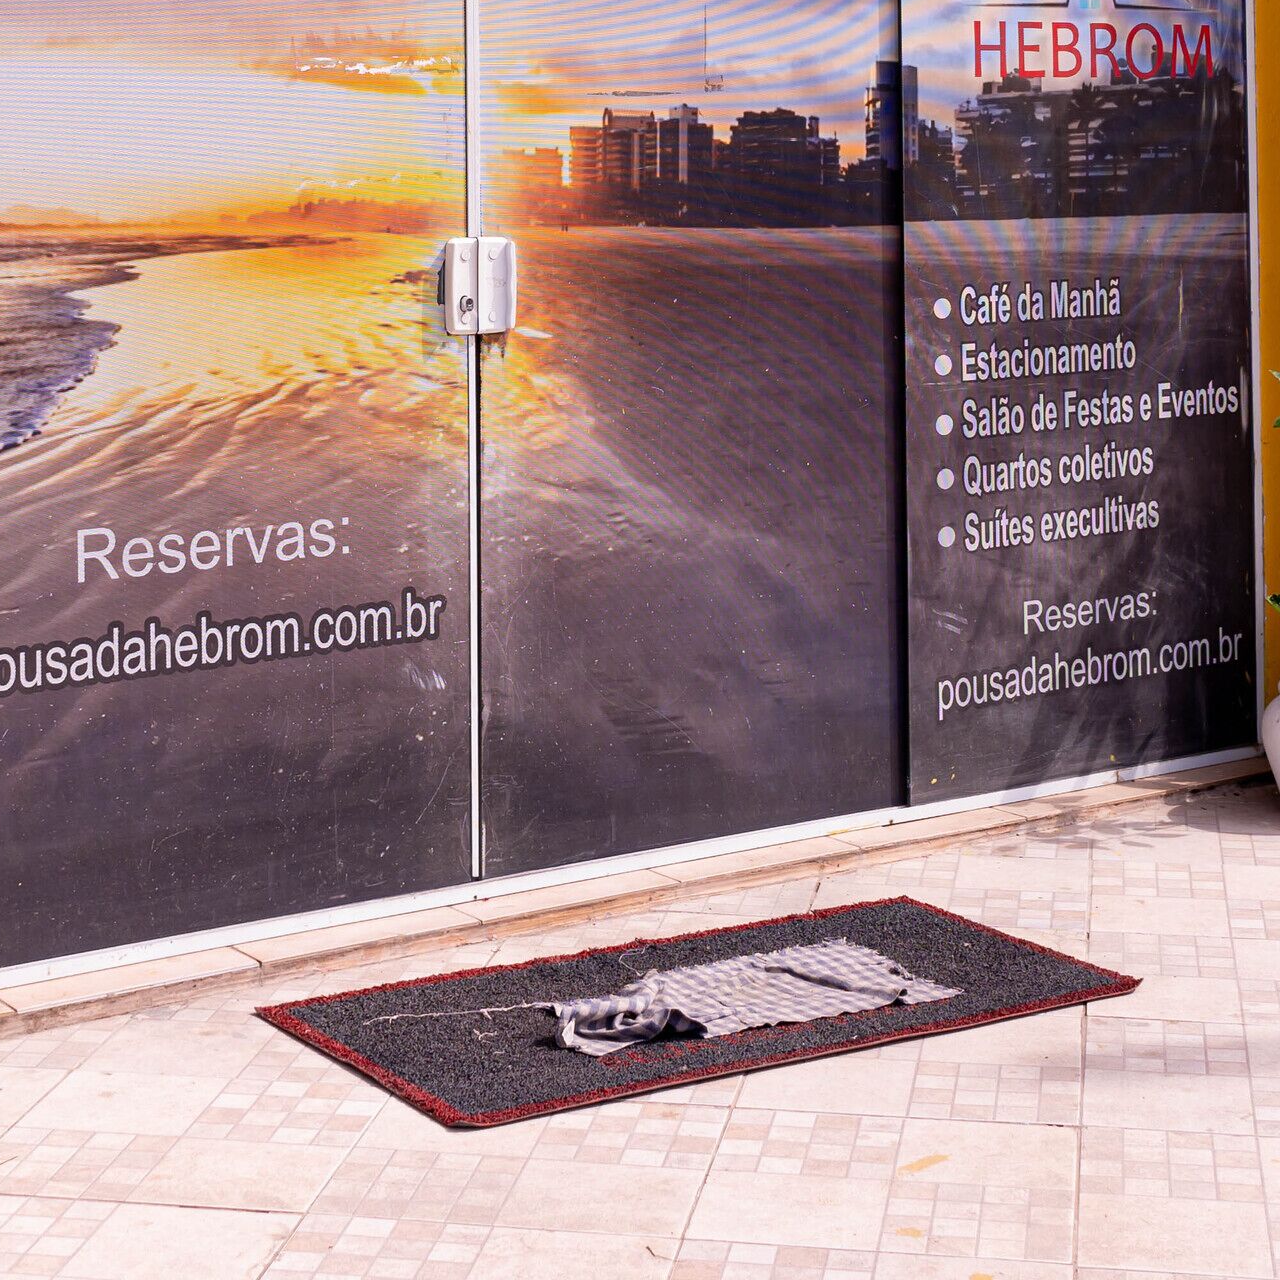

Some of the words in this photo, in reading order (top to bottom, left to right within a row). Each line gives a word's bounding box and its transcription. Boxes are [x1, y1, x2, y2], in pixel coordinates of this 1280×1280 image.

[973, 20, 1214, 80] HEBROM
[960, 282, 1011, 325] Café
[1017, 282, 1043, 321] da
[1051, 277, 1121, 320] Manhã
[961, 334, 1137, 382] Estacionamento
[962, 396, 1025, 439] Salão
[1031, 393, 1058, 432] de
[1064, 389, 1133, 429] Festas
[1139, 393, 1152, 421] e
[1157, 380, 1239, 419] Eventos
[963, 452, 1052, 496] Quartos
[1058, 441, 1154, 486] coletivos
[77, 517, 350, 584] Reservas:
[964, 508, 1034, 552] Suítes
[1041, 495, 1160, 542] execultivas
[1023, 590, 1157, 635] Reservas:
[938, 626, 1243, 721] pousadahebrom.com.br
